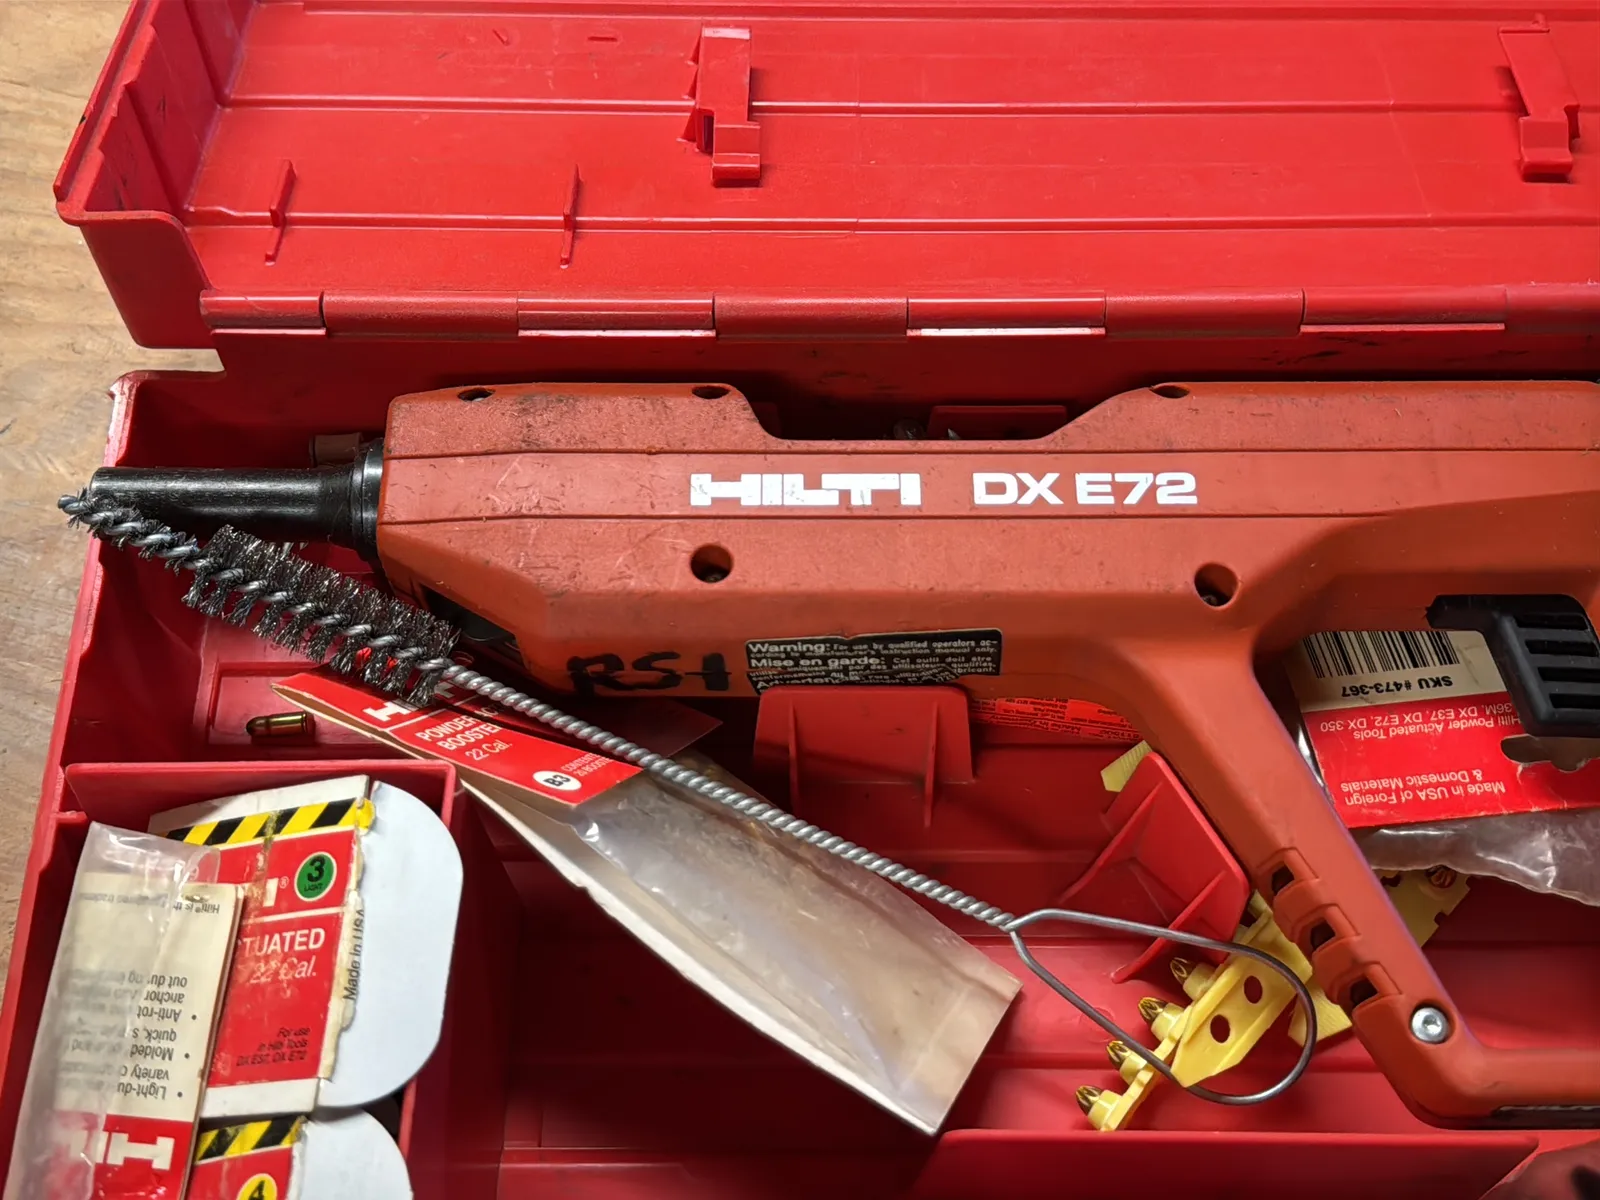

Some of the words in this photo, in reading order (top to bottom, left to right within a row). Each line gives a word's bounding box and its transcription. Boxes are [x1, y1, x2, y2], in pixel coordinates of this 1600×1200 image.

[691, 473, 921, 506] HILTI
[973, 473, 1063, 504] DX
[1075, 472, 1198, 505] E72
[748, 642, 831, 653] Warning:
[888, 640, 928, 650] qualified
[932, 638, 975, 648] operators
[751, 658, 794, 667] Mise
[827, 656, 886, 668] garde:
[1341, 680, 1412, 697] #473-367
[1418, 675, 1453, 690] SKU
[1403, 712, 1423, 724] DX
[1459, 706, 1478, 718] DX
[1320, 720, 1344, 733] 350
[1348, 718, 1367, 730] DX
[1389, 722, 1444, 738] Actuated
[1448, 718, 1494, 730] Powder
[1353, 728, 1388, 740] Tools
[465, 748, 490, 761] 22
[482, 739, 512, 753] Cal.
[542, 774, 571, 787] B3
[1405, 770, 1470, 787] Domestic
[1472, 769, 1483, 781] &
[1340, 776, 1403, 793] Materials
[1452, 782, 1465, 795] in
[1467, 780, 1506, 795] Made
[1344, 791, 1397, 806] Foreign
[1400, 789, 1414, 803] of
[1418, 787, 1449, 800] USA
[307, 856, 326, 882] 3
[240, 927, 325, 957] TUATED
[349, 942, 362, 957] in
[168, 975, 188, 988] out
[343, 960, 360, 1001] Made
[144, 990, 185, 1004] anchor
[130, 1044, 174, 1061] Molded
[117, 1081, 167, 1100] Light-du
